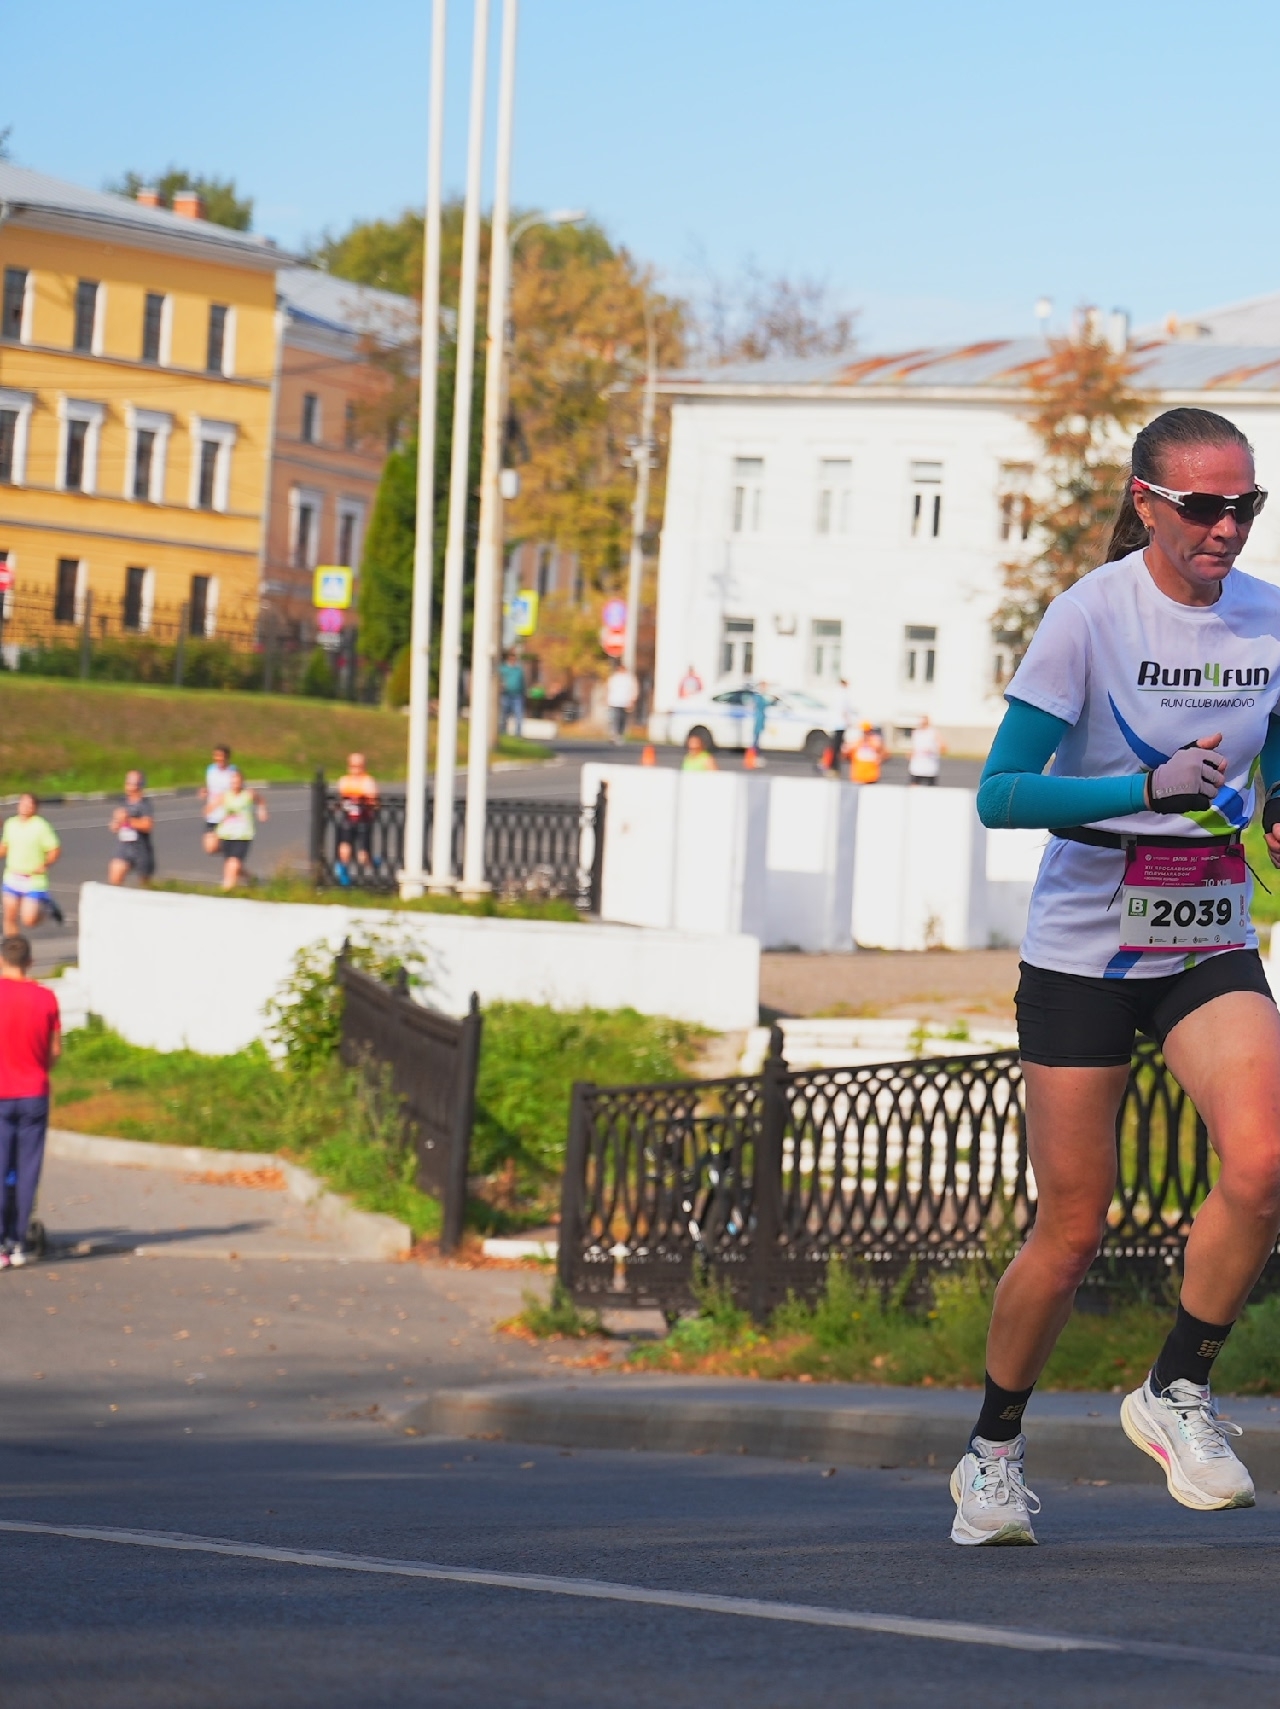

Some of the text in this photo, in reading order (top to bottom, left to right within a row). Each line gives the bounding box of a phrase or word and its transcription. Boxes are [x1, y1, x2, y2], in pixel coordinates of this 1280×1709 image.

[1137, 661, 1270, 687] Run4fun
[1160, 698, 1255, 708] RUN CLUB IVANOVO
[1150, 898, 1231, 927] 2039
